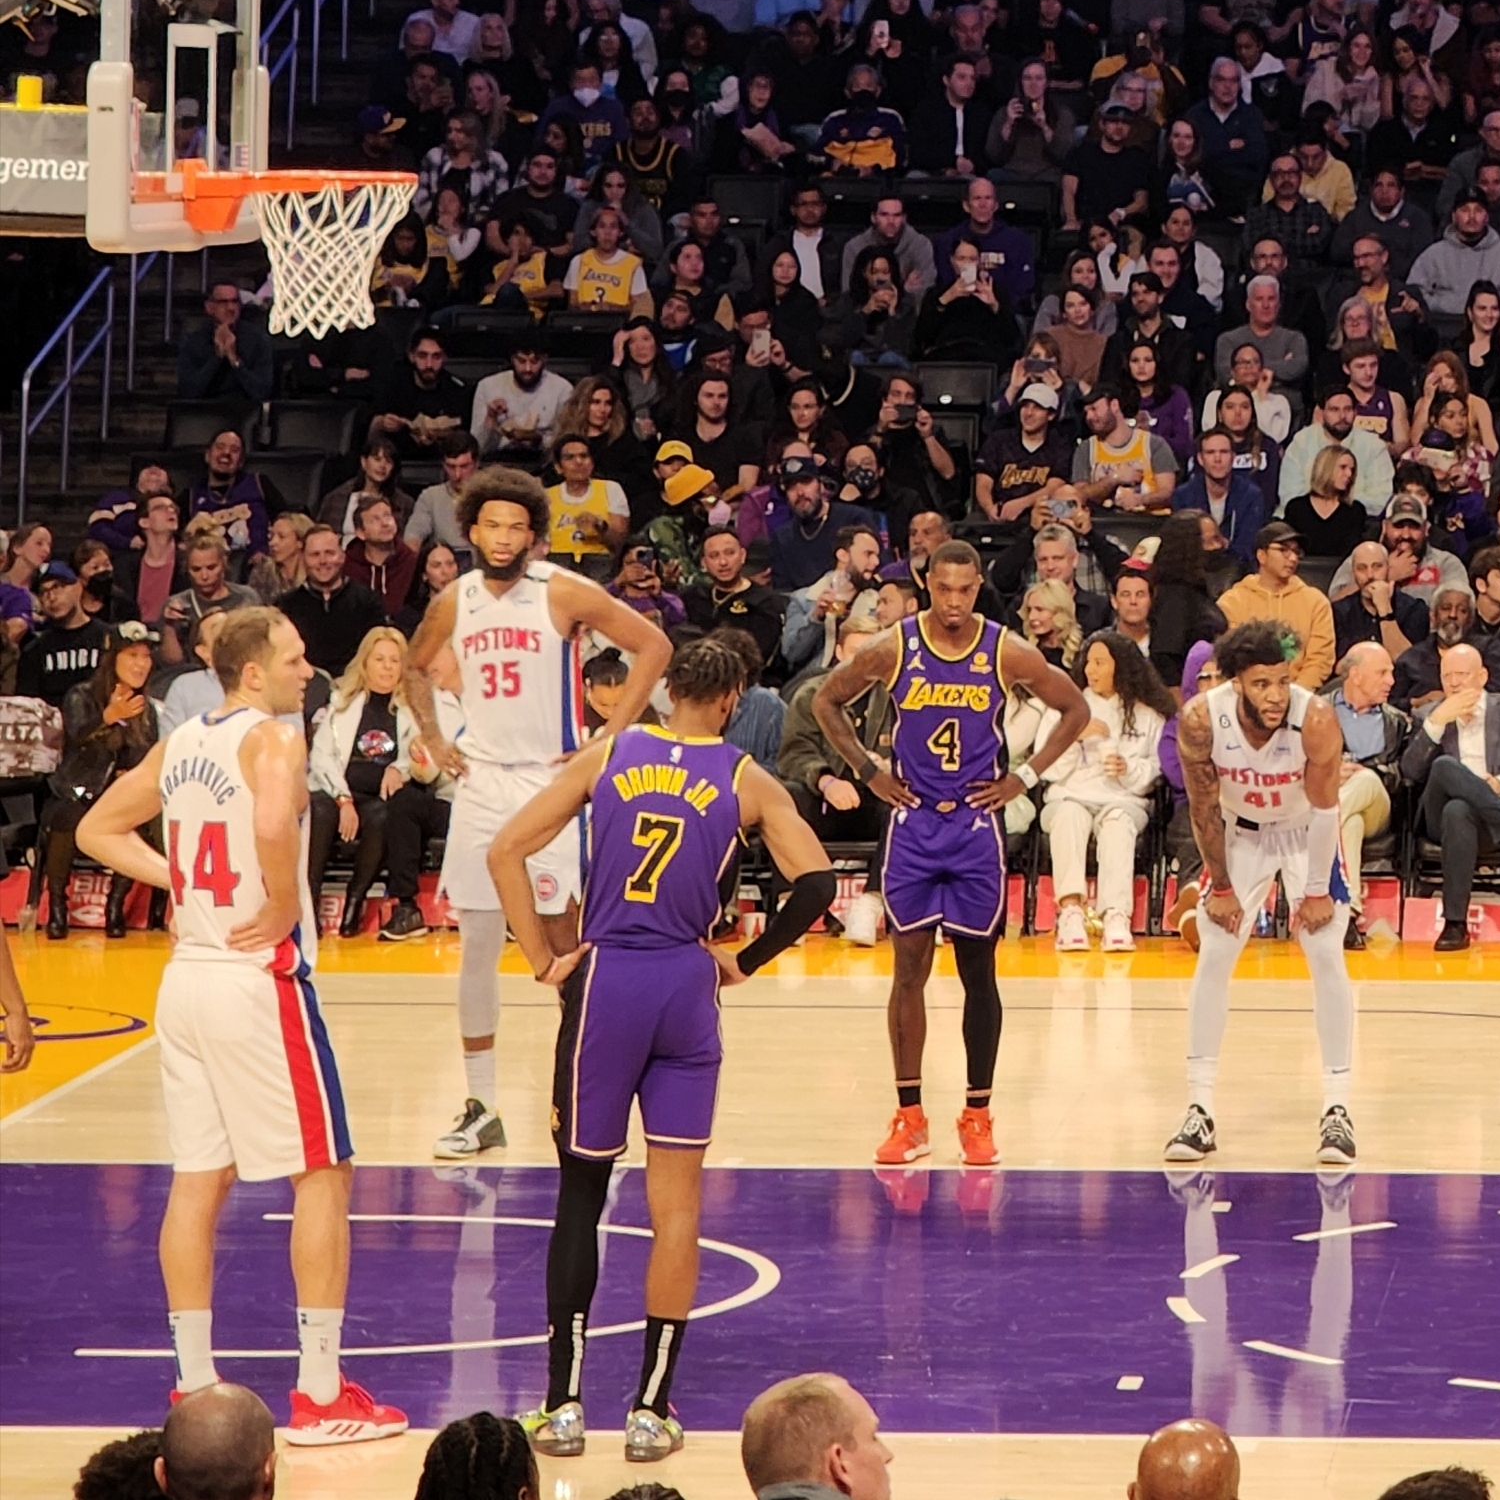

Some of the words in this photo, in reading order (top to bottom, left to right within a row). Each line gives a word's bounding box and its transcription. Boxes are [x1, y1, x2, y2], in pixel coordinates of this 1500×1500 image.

[461, 626, 542, 660] PISTONS
[480, 660, 521, 699] 35
[899, 676, 992, 712] LAKERS
[1219, 713, 1232, 729] 6
[926, 717, 960, 771] 4
[612, 764, 689, 802] BROWN
[684, 778, 720, 817] JR.
[1217, 766, 1302, 789] PISTONS
[1243, 790, 1282, 809] 41
[624, 811, 686, 904] 7
